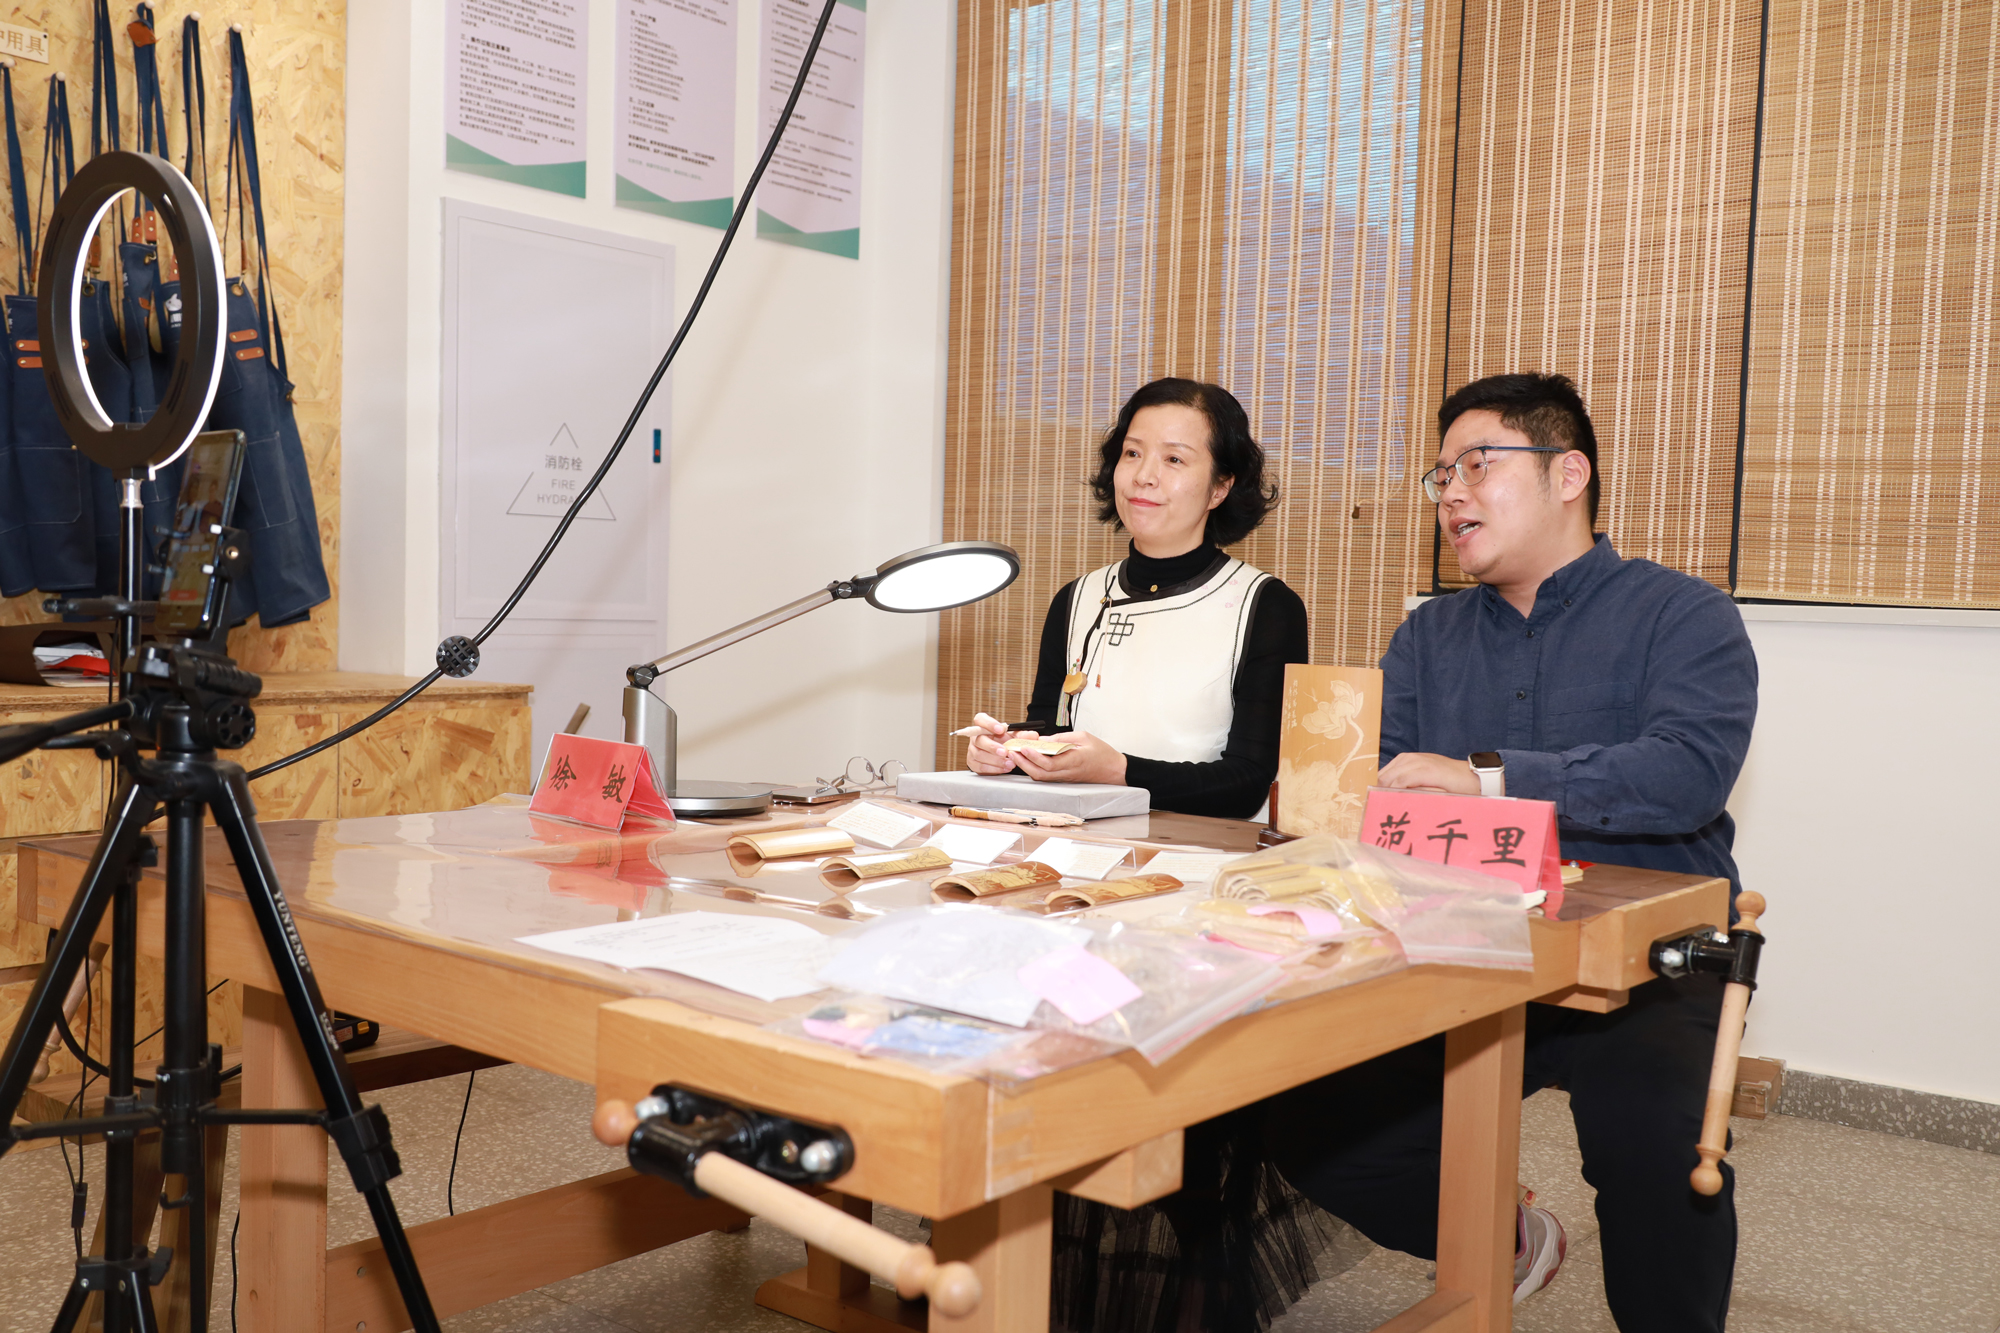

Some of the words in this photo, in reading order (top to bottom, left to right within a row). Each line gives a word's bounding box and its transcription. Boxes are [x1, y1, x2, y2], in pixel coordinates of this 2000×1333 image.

[545, 455, 583, 471] 消防栓
[537, 494, 587, 505] HYDRA
[551, 479, 576, 490] FIRE
[549, 754, 626, 803] 徐敏
[1376, 811, 1526, 867] 范千里
[273, 890, 309, 968] YUNTENG
